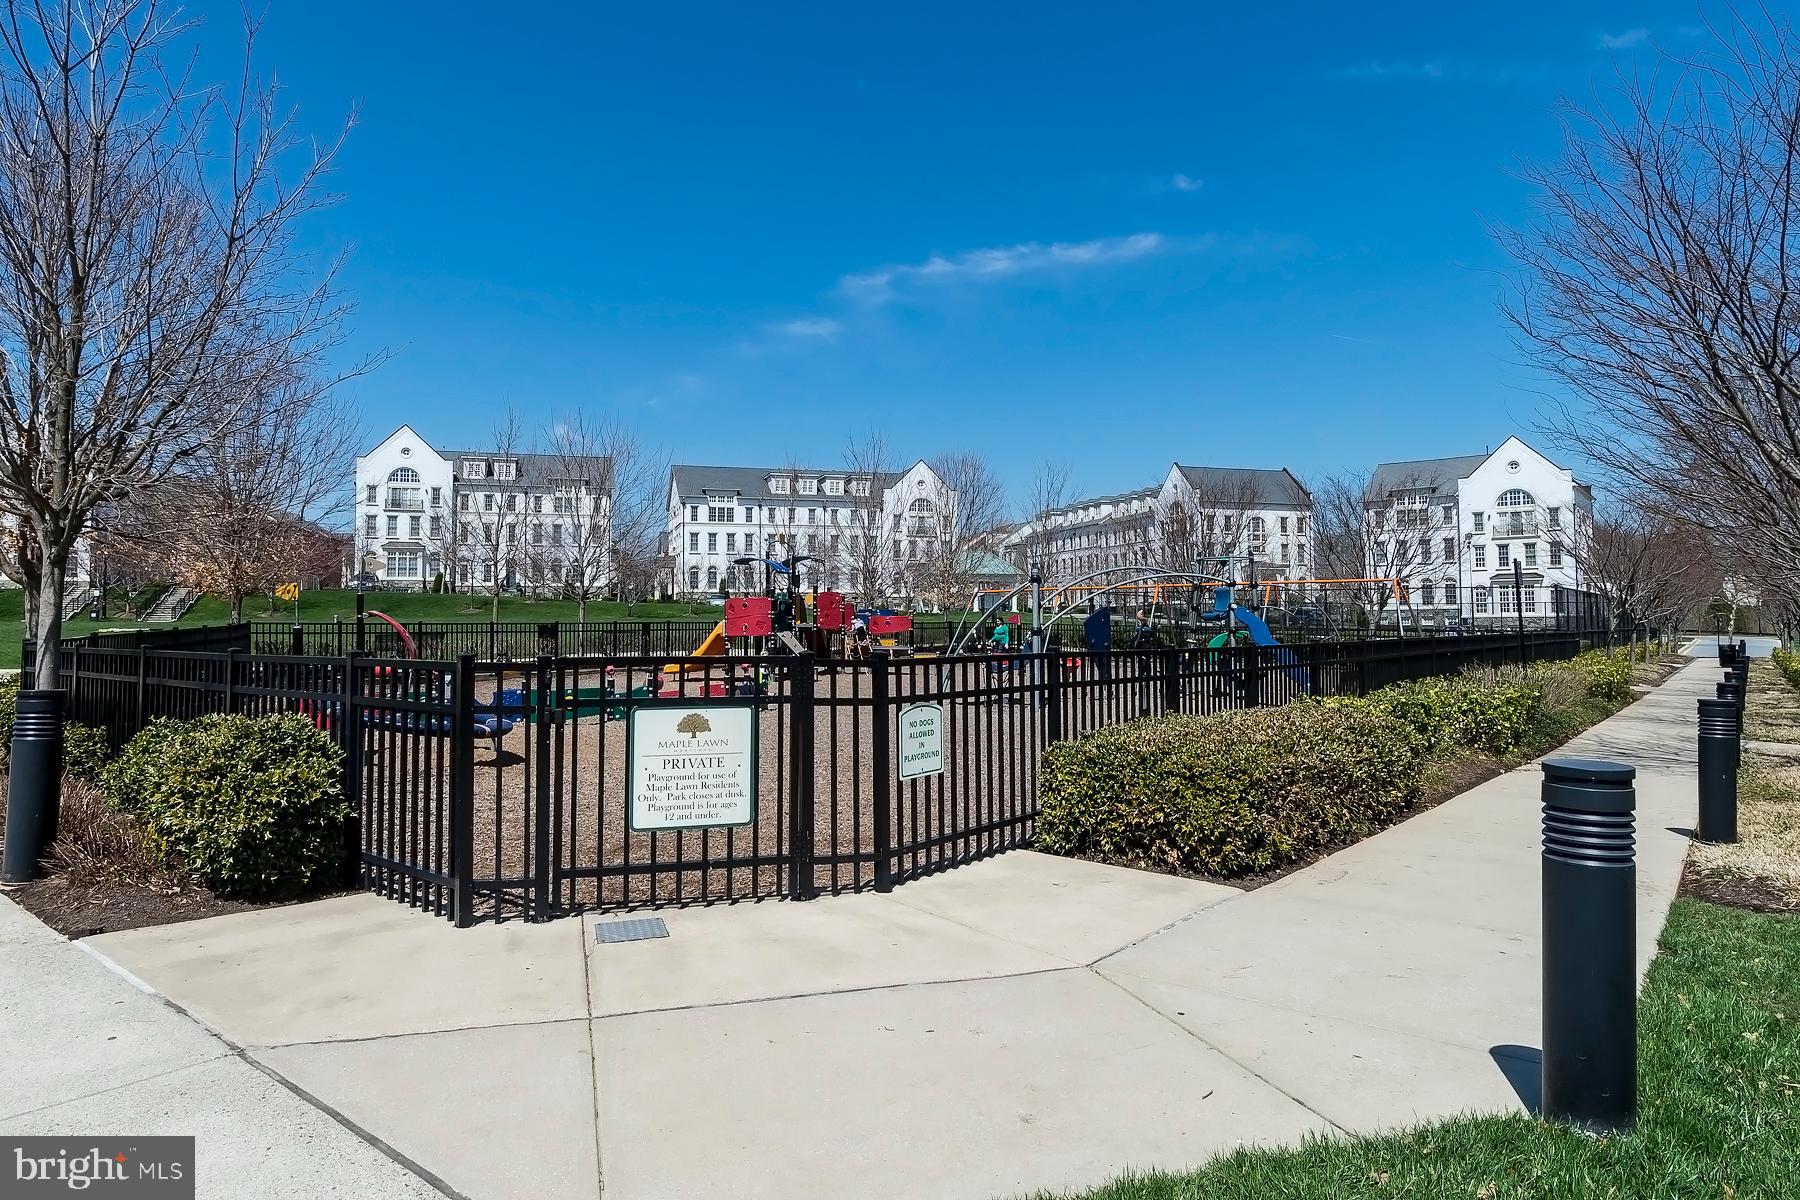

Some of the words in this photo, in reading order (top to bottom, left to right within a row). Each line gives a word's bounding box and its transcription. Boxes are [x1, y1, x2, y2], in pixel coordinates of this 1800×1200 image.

[909, 730, 934, 739] ALLOWED
[658, 739, 693, 749] MAPLE
[697, 739, 728, 747] LAWN
[904, 750, 939, 762] PLAYGROUND
[663, 757, 725, 769] PRIVATE
[648, 772, 696, 784] Playground
[697, 771, 711, 780] for
[728, 770, 737, 778] of
[646, 782, 673, 793] Maple
[675, 782, 698, 791] Lawn
[701, 780, 740, 790] Residents
[637, 793, 662, 804] Only.
[667, 792, 687, 801] Park
[688, 791, 714, 800] closes
[724, 789, 747, 799] dusk.
[647, 801, 695, 813] Playground
[697, 800, 704, 809] is
[706, 800, 719, 809] for
[720, 801, 738, 809] ages
[665, 812, 675, 821] 12
[676, 811, 693, 820] and
[694, 810, 722, 819] under.
